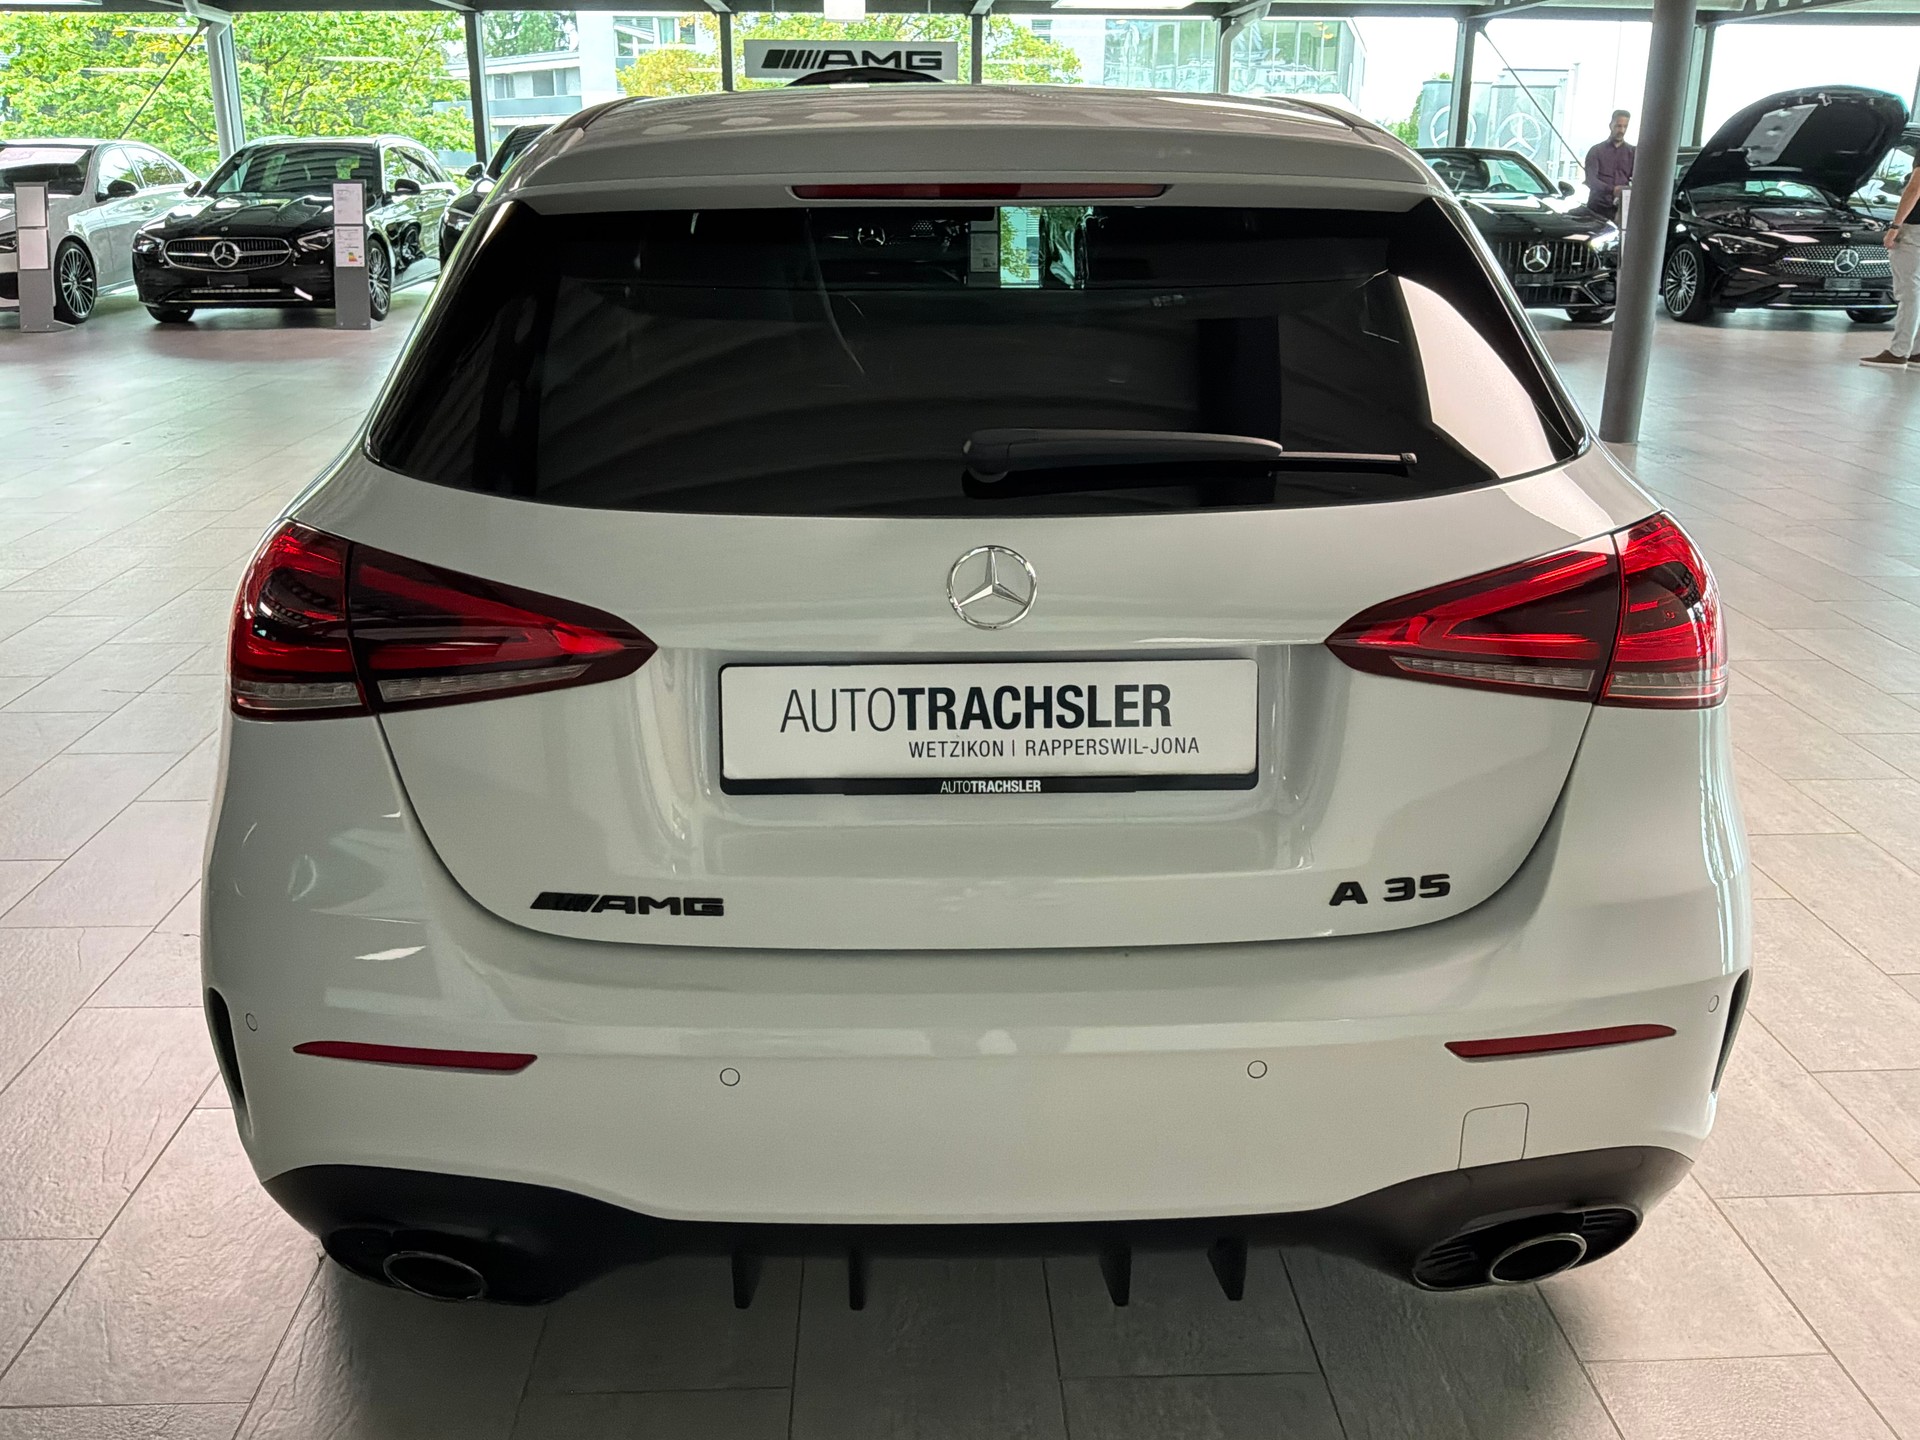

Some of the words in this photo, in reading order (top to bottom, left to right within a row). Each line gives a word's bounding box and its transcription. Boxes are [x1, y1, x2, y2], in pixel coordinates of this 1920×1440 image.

[817, 50, 943, 71] AMG
[780, 683, 1173, 734] AUTOTRACHSLER
[908, 739, 1005, 758] WETZIKON
[1025, 737, 1200, 757] RAPPERSWIL-JONA
[940, 779, 1042, 794] AUTOTRACHSLER
[1328, 881, 1369, 906] A
[1382, 873, 1451, 902] 35
[590, 894, 725, 916] AMG
